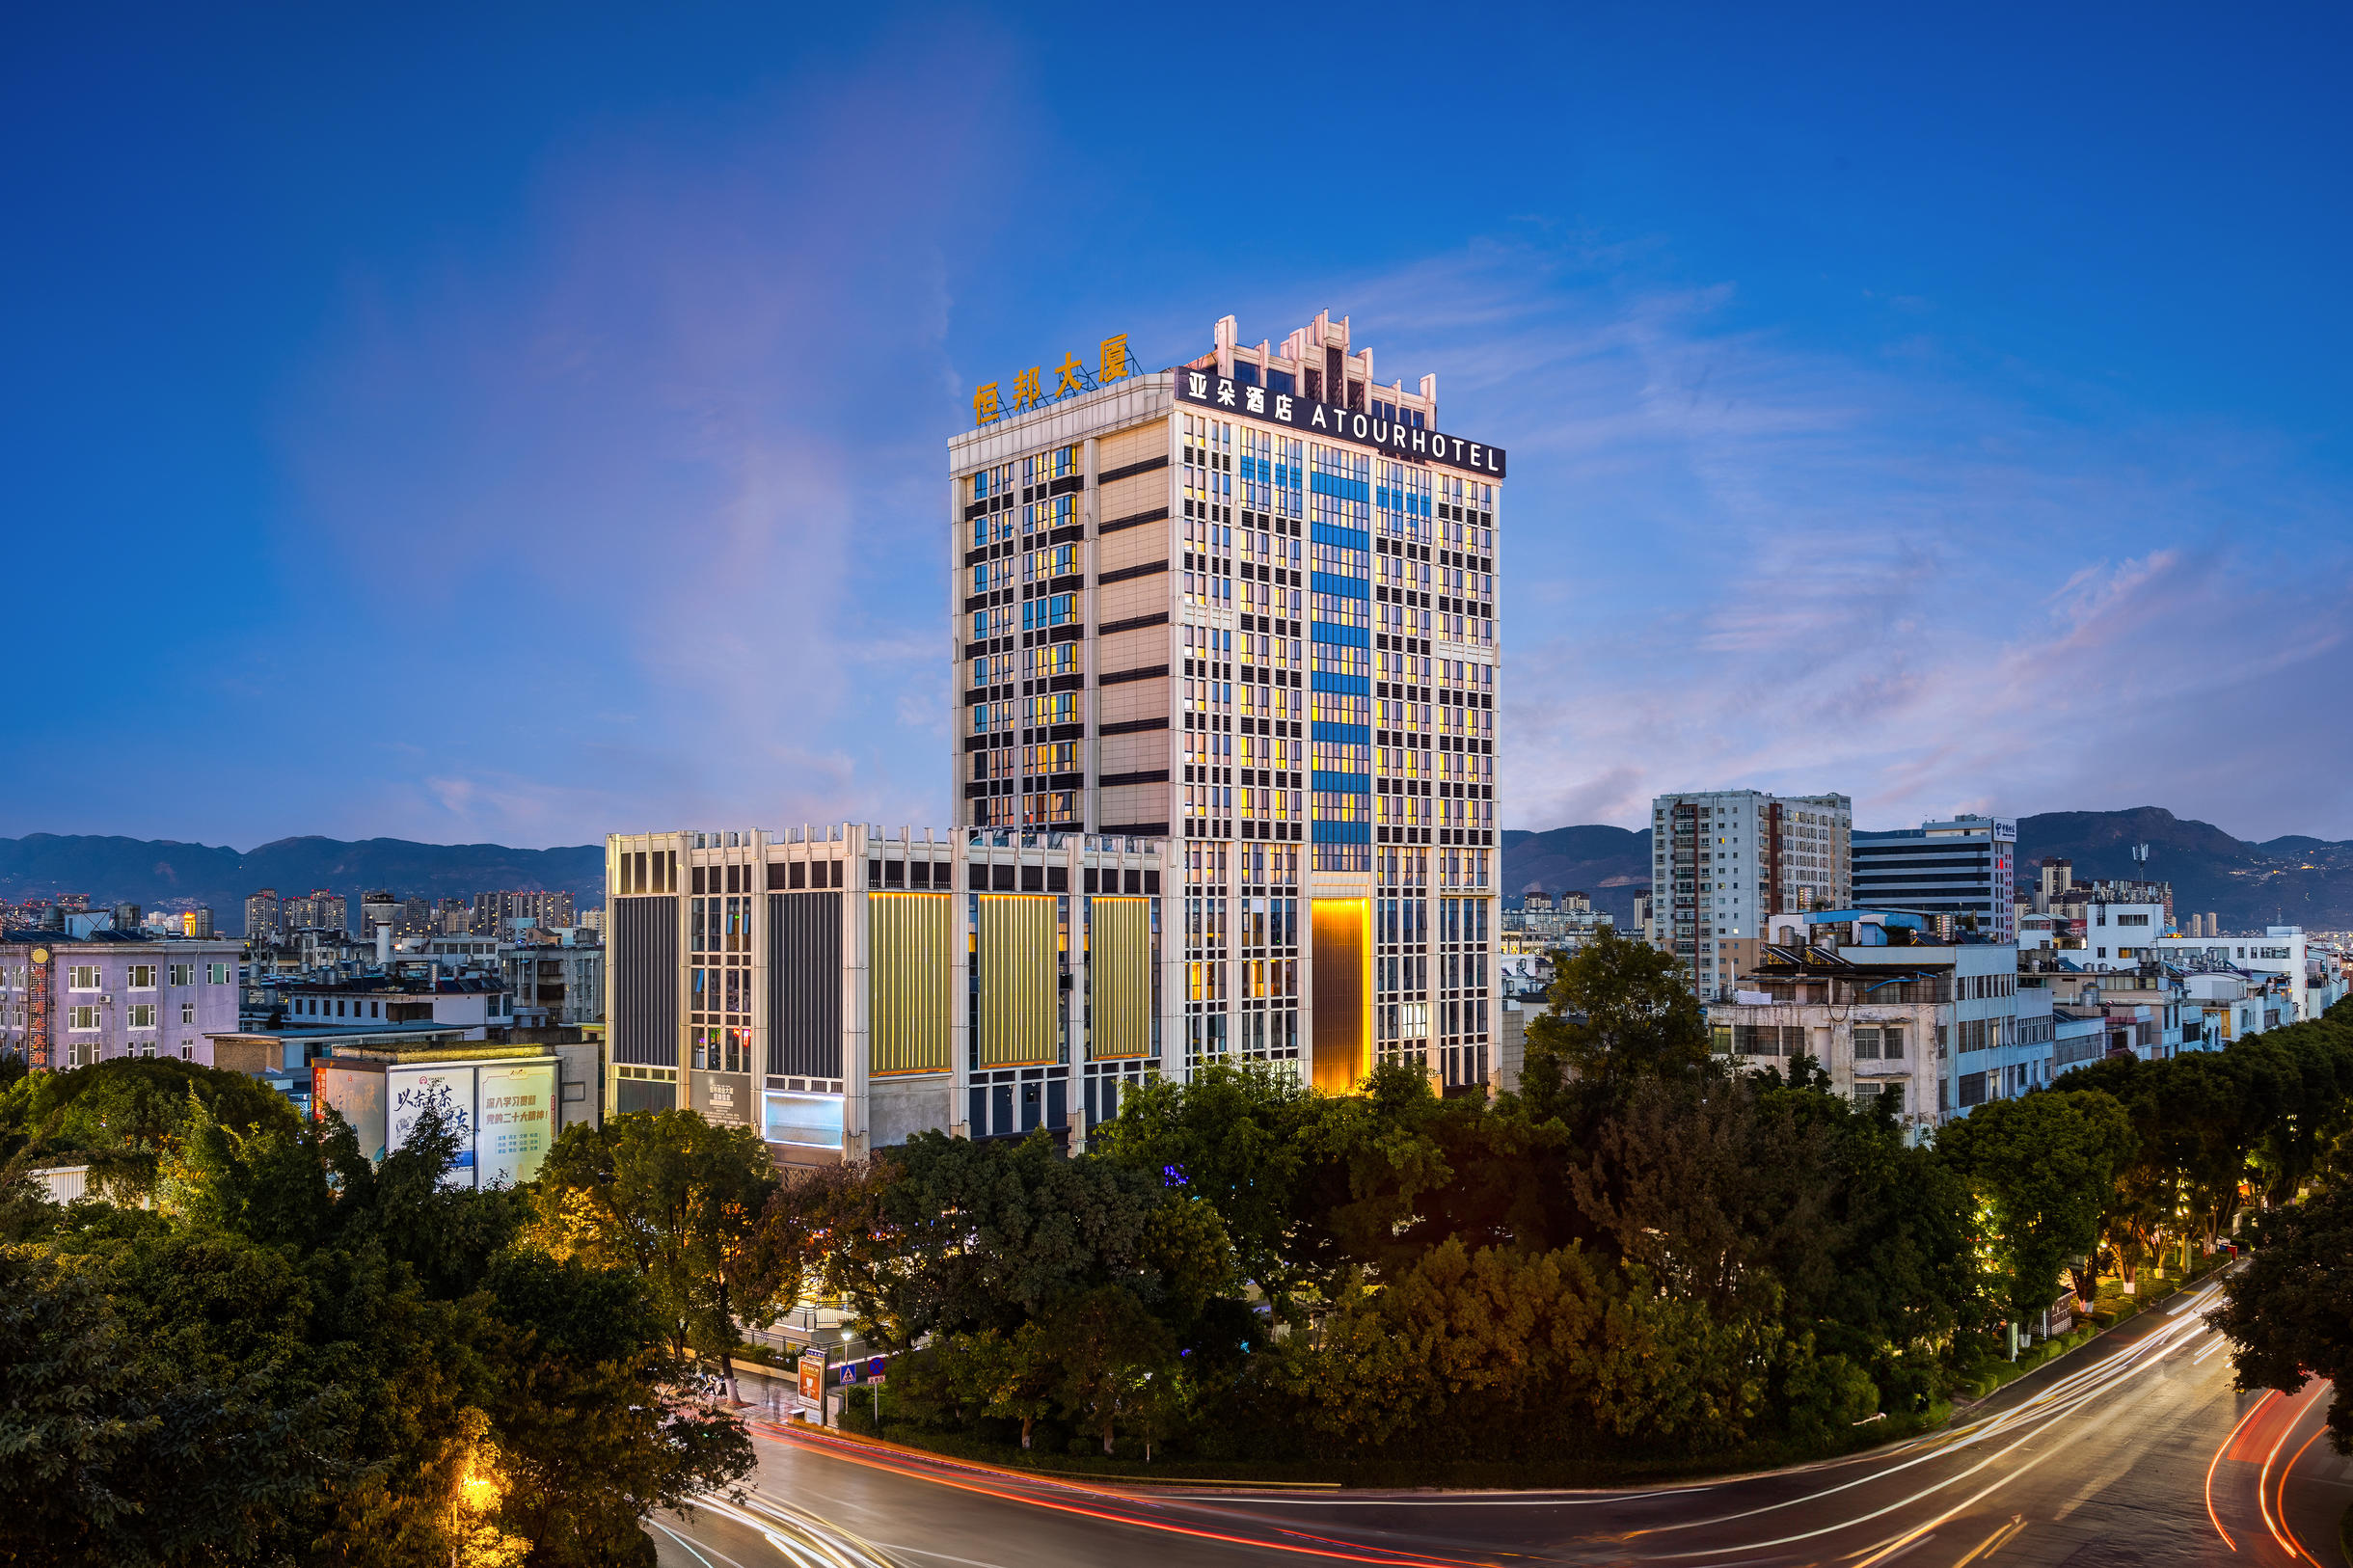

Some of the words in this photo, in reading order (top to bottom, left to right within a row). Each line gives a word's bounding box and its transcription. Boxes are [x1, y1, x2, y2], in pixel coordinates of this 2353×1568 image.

[973, 333, 1128, 426] 恒邦大厦
[1188, 371, 1293, 421] 亚朵酒店
